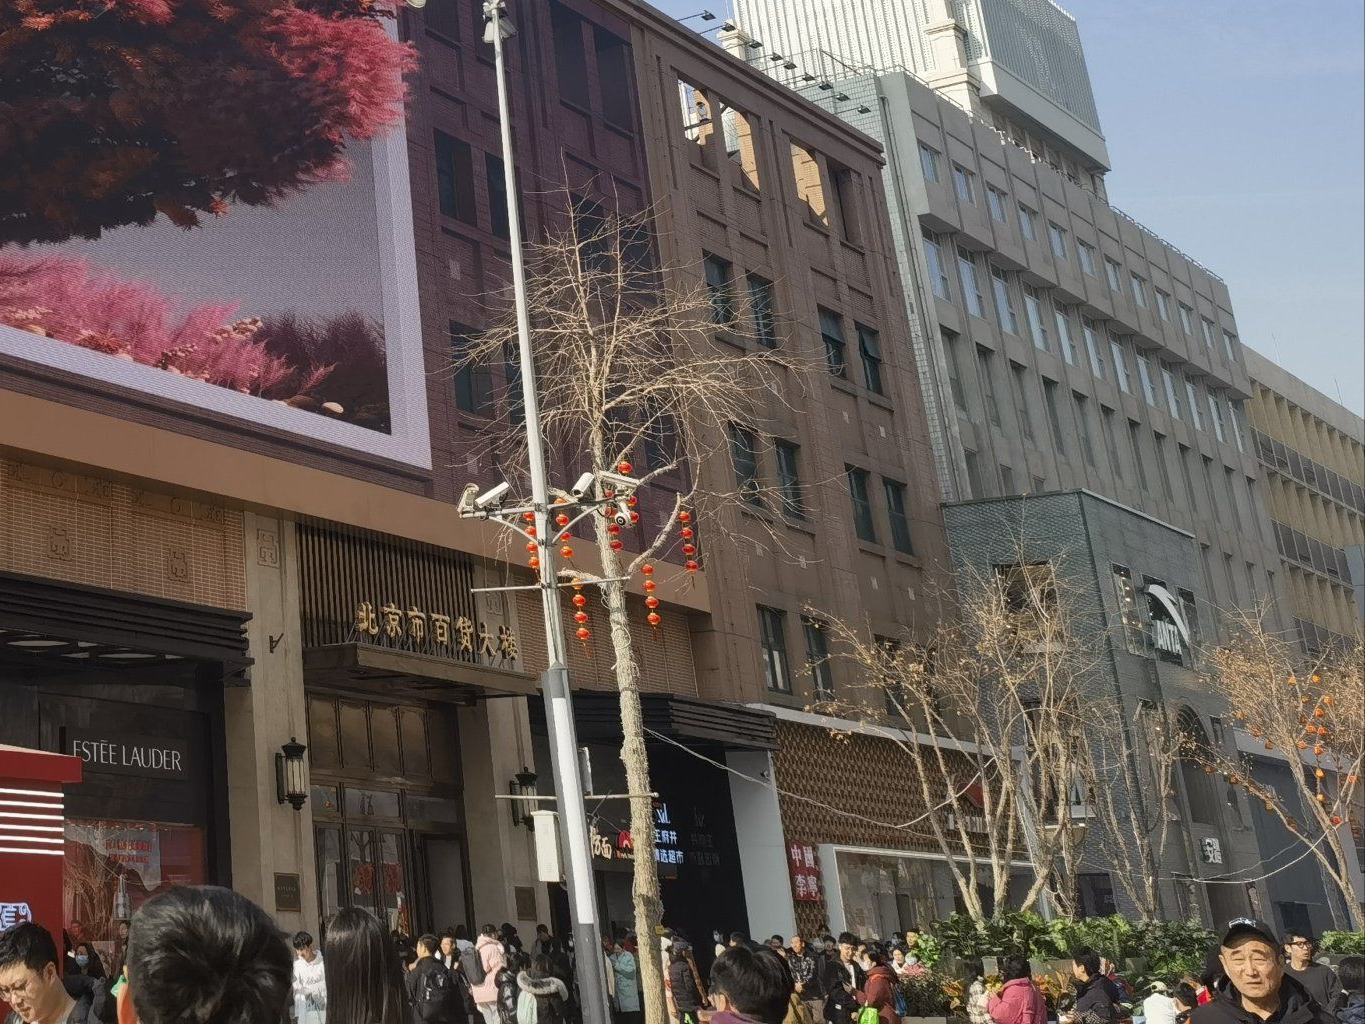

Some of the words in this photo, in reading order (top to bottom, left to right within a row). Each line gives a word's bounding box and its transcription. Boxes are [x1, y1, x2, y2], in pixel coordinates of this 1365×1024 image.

[356, 600, 519, 661] 北京市百货大楼
[122, 745, 182, 772] LAUDER
